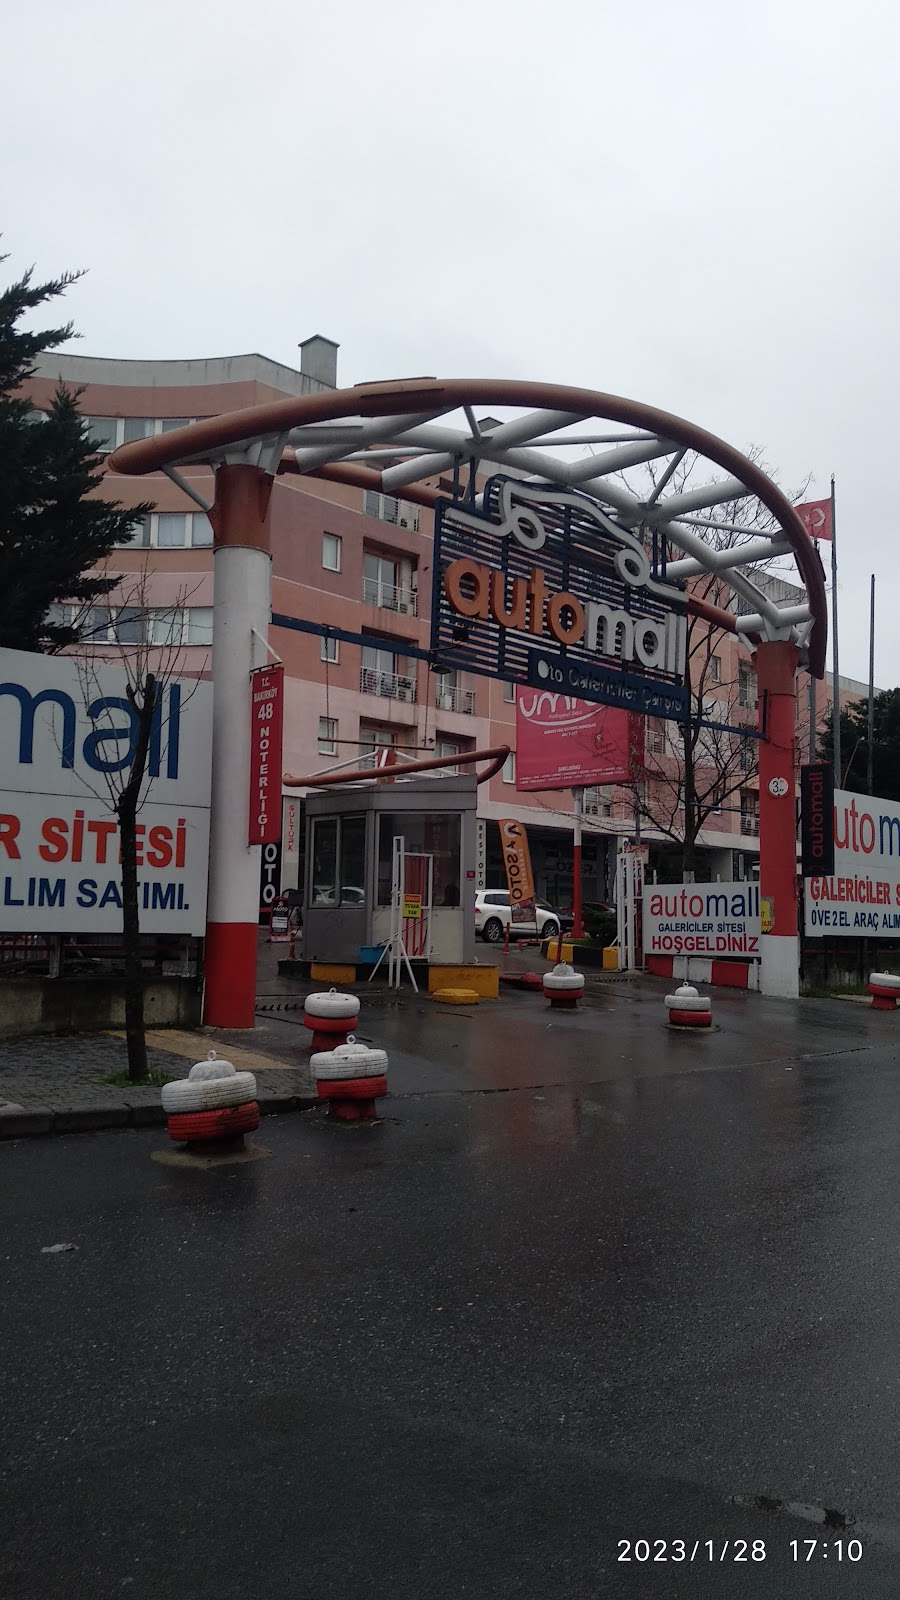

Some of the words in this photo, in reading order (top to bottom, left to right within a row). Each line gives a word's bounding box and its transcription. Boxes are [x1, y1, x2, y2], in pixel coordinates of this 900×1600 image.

[444, 558, 686, 675] automall
[537, 659, 564, 683] Oto
[257, 702, 274, 721] 48
[808, 771, 824, 858] automall
[262, 843, 277, 905] OTO
[810, 874, 891, 905] GALERİCİLER
[76, 878, 190, 910] SAIMI.
[650, 886, 759, 918] automall
[658, 921, 714, 933] GALERİCİLER
[717, 921, 746, 933] SİTESİ
[854, 912, 879, 931] ARAÇ
[652, 933, 759, 953] HOŞGELDİNİZ
